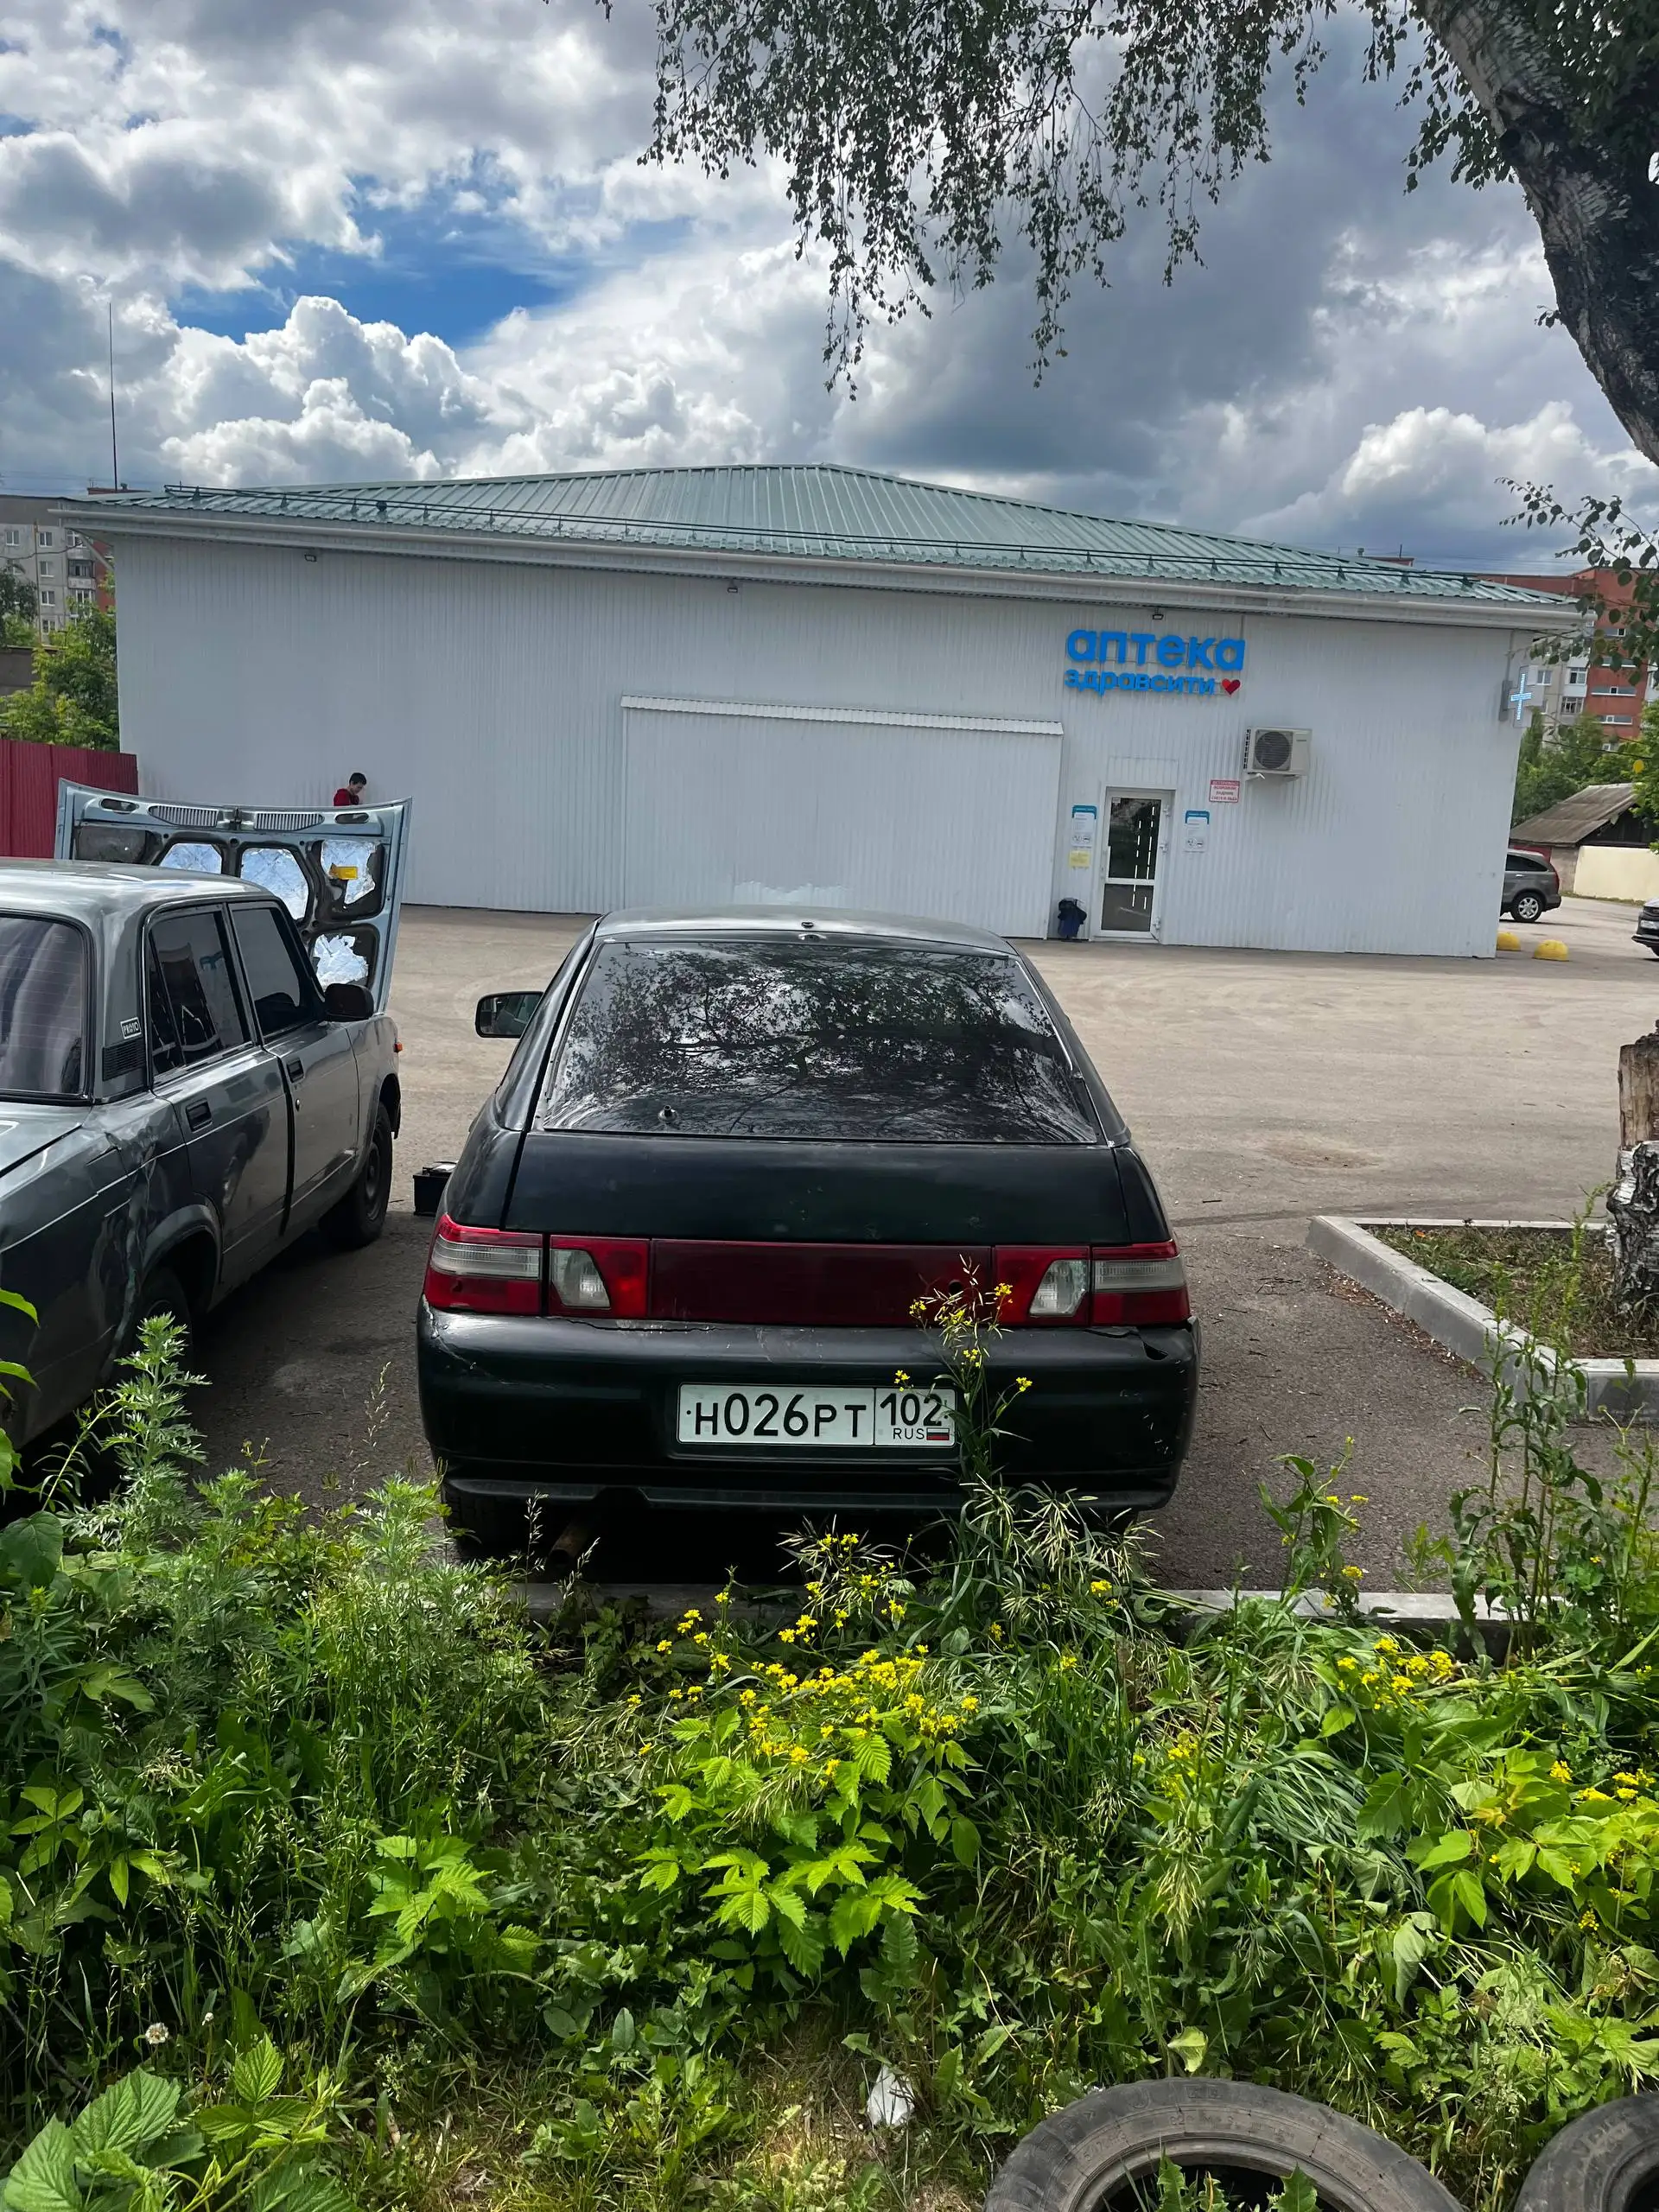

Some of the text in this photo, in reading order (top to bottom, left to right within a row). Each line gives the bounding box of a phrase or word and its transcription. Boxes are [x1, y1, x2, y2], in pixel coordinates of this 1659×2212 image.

[1066, 629, 1246, 671] аптека
[1064, 669, 1216, 697] здравсити
[880, 1393, 943, 1427] 102
[893, 1427, 925, 1440] RUS
